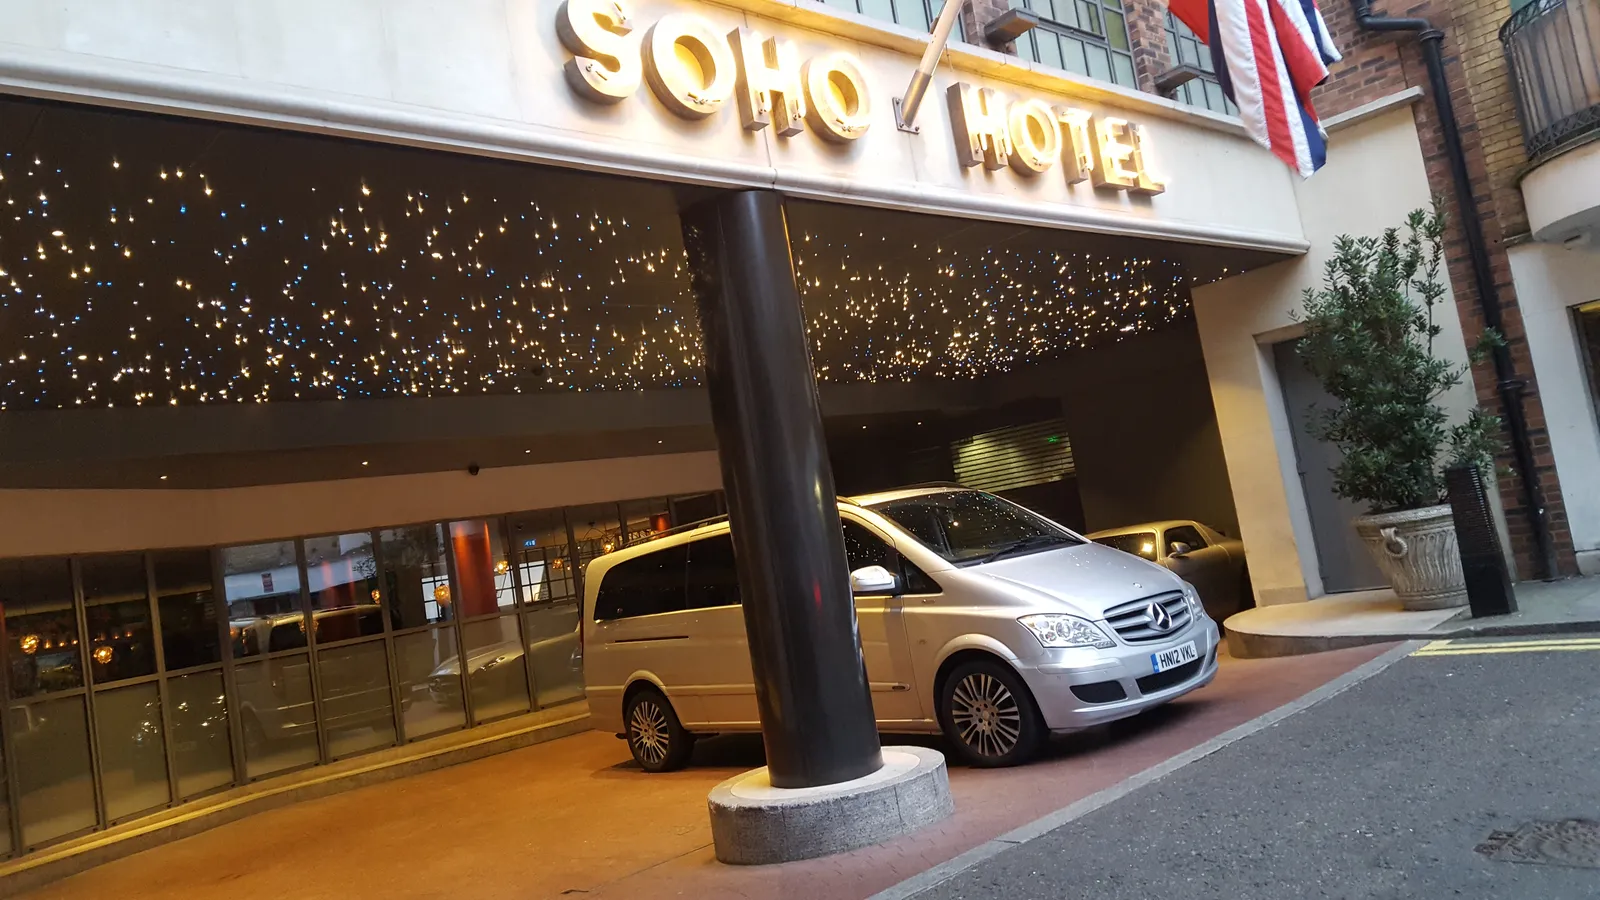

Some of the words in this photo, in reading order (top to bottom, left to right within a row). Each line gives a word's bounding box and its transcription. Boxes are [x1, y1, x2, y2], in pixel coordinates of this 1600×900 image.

[556, 0, 871, 144] SOHO
[946, 81, 1169, 196] HOTEL
[1159, 649, 1181, 668] HN12
[1179, 645, 1196, 661] VKL
